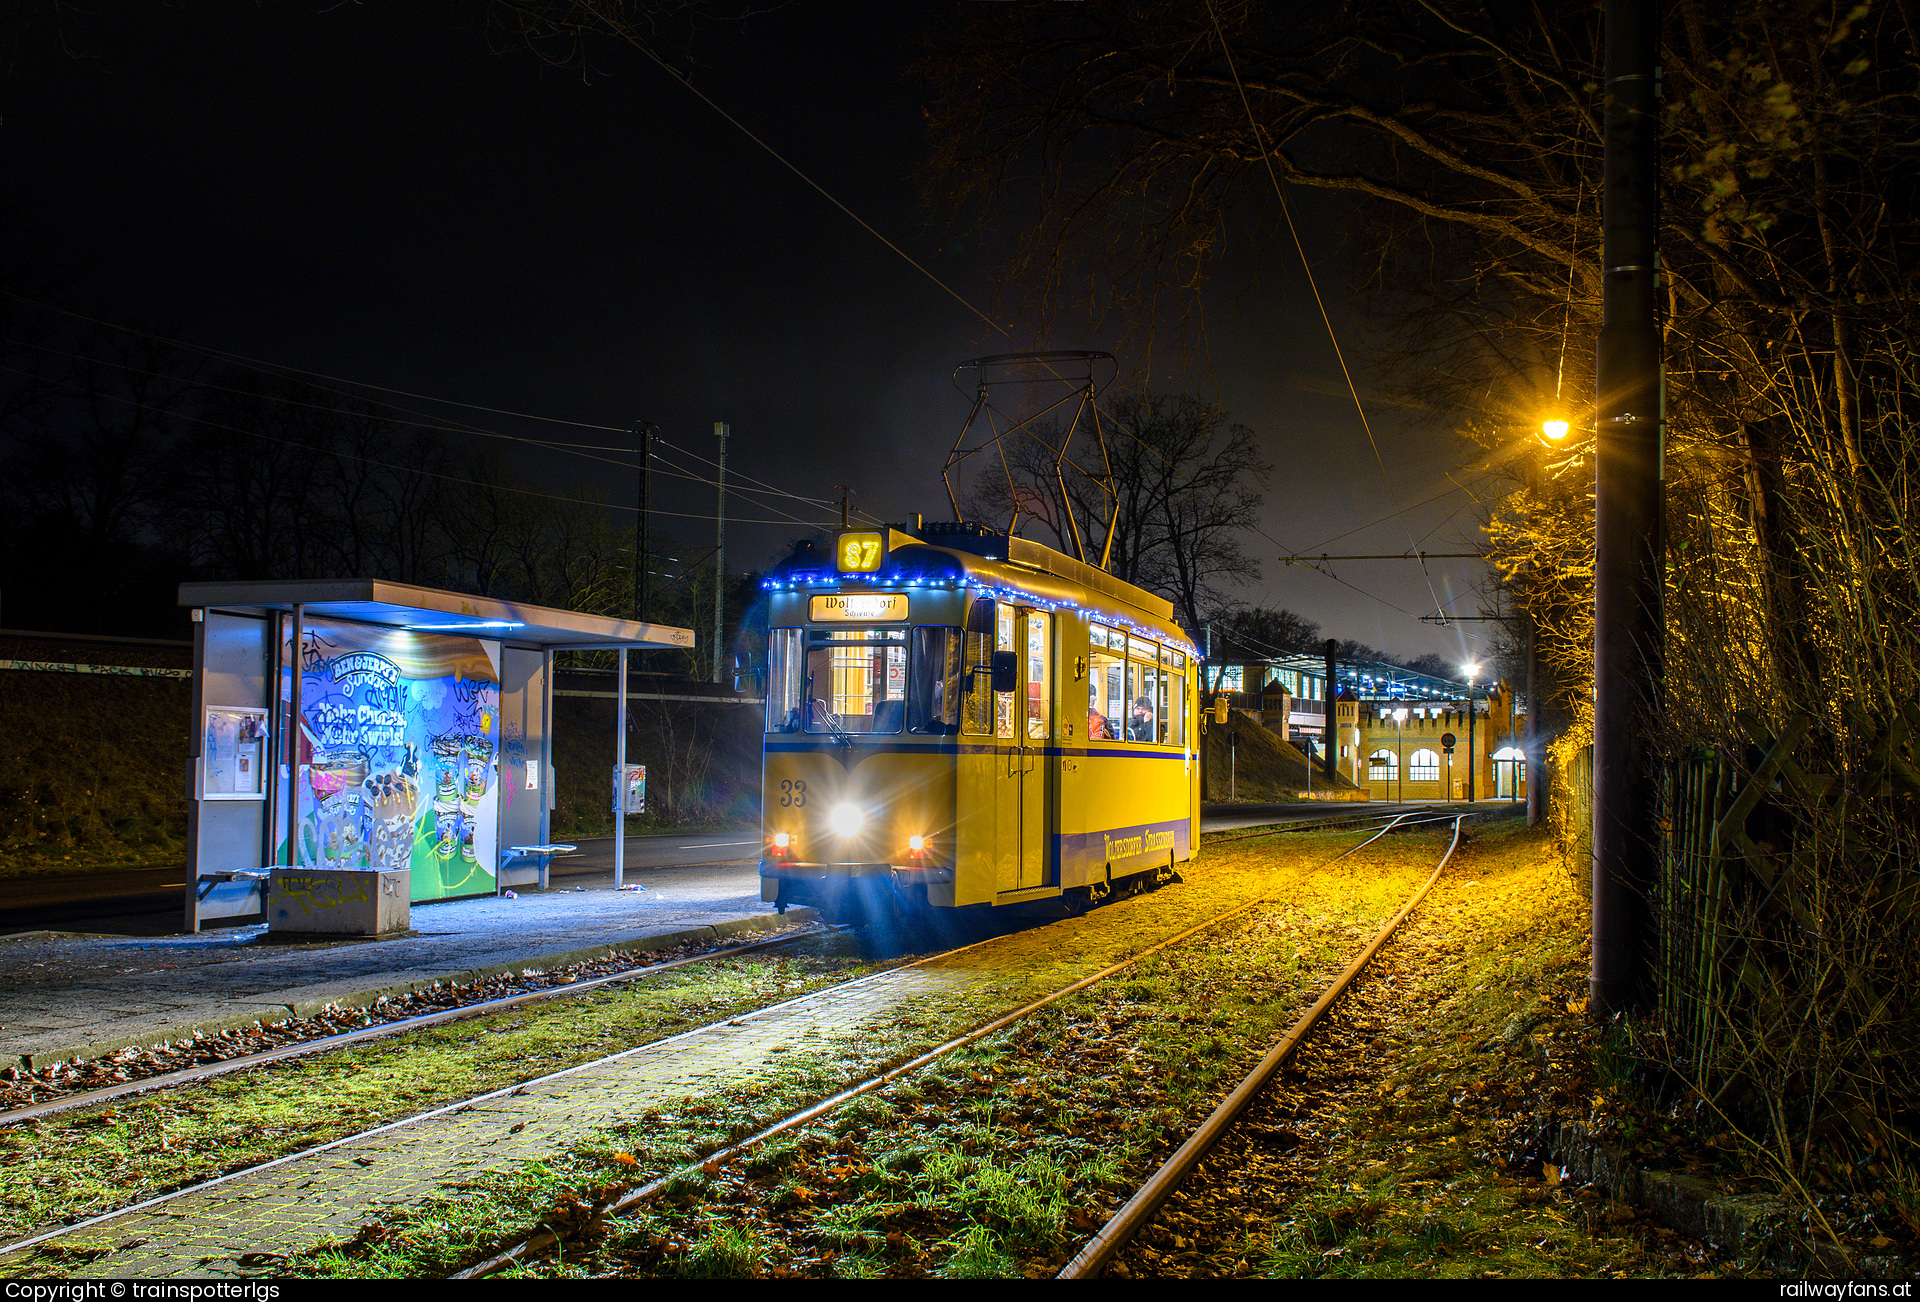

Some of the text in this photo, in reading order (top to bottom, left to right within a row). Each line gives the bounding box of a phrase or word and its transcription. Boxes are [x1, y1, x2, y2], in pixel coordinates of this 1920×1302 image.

[845, 541, 878, 568] 87
[825, 597, 897, 610] Wolorf
[780, 779, 807, 807] 33
